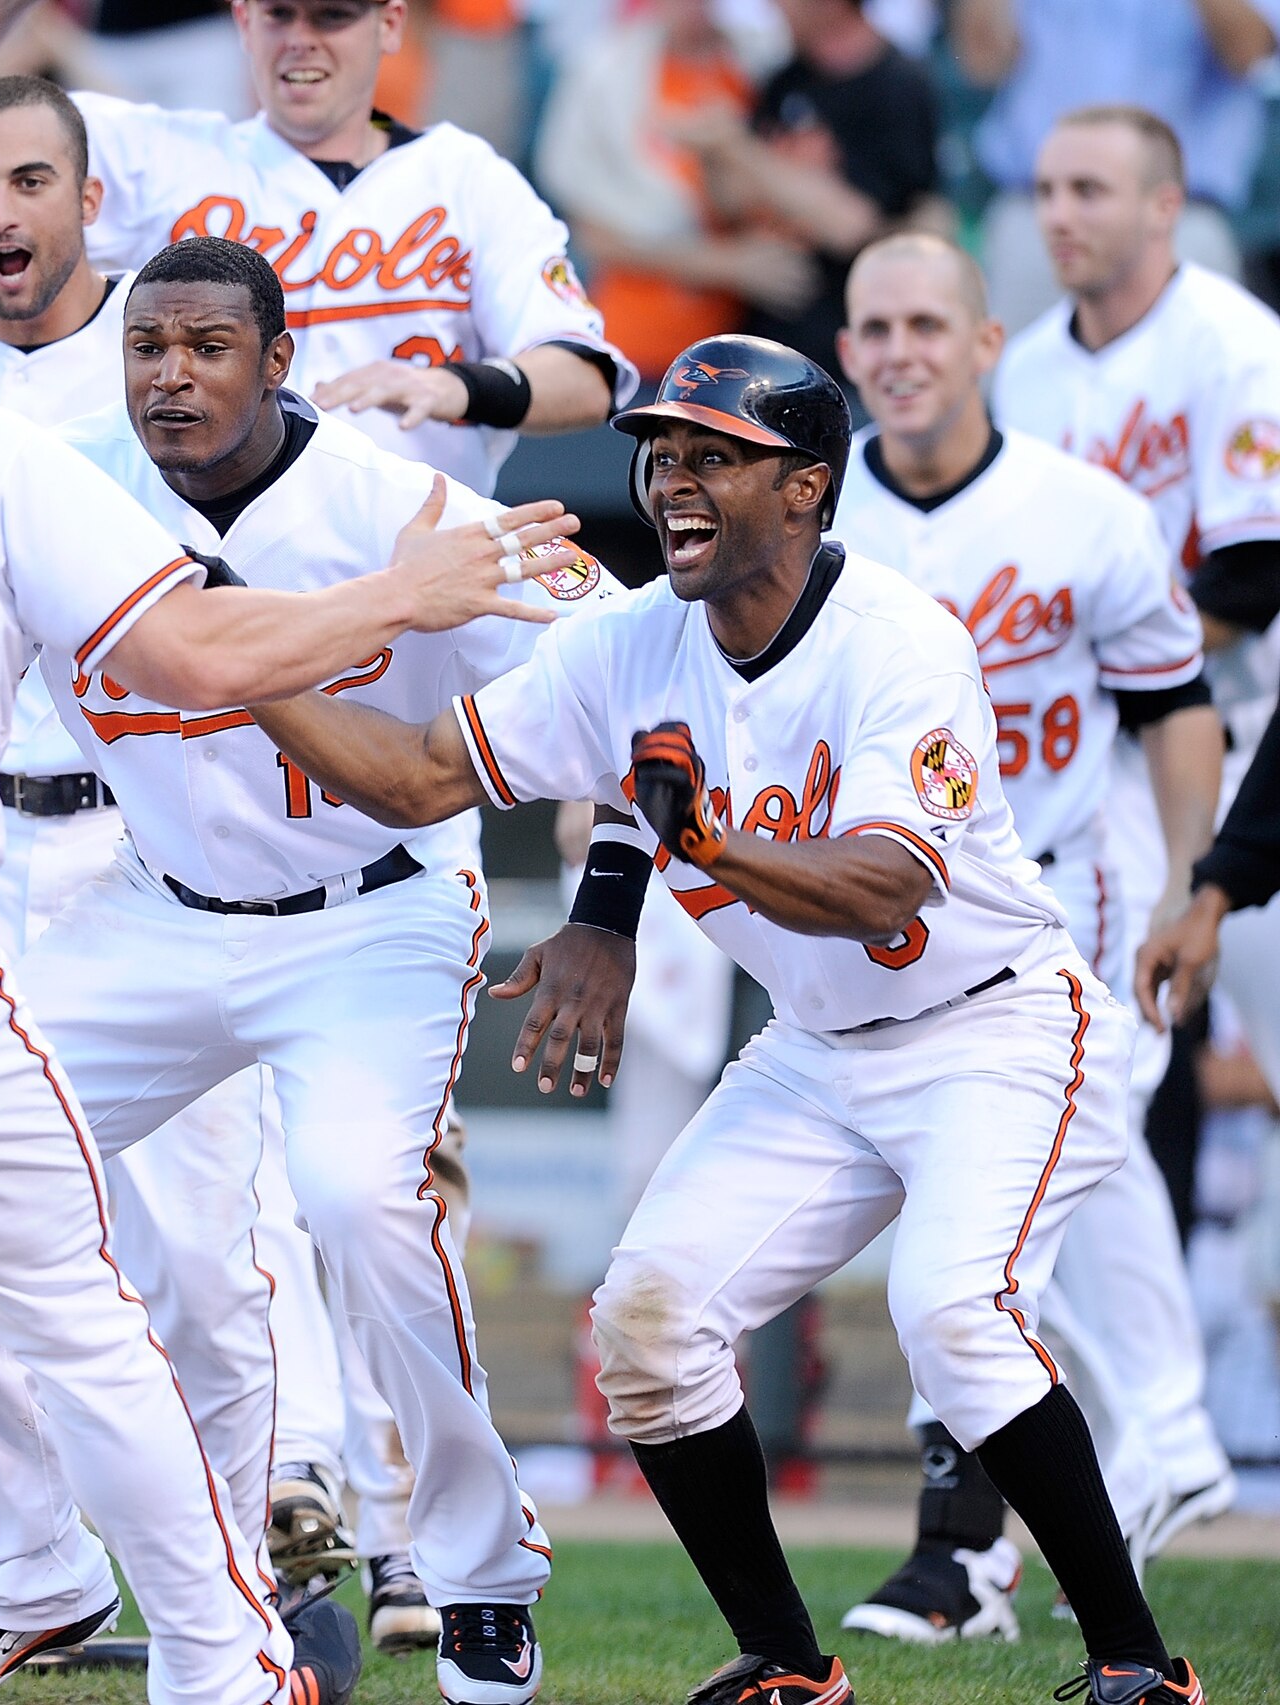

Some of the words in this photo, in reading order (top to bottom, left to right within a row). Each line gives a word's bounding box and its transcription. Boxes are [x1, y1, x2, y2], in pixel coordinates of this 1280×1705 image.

[556, 564, 599, 599] ORIOLES
[992, 693, 1079, 777] 58
[275, 750, 346, 819] 1
